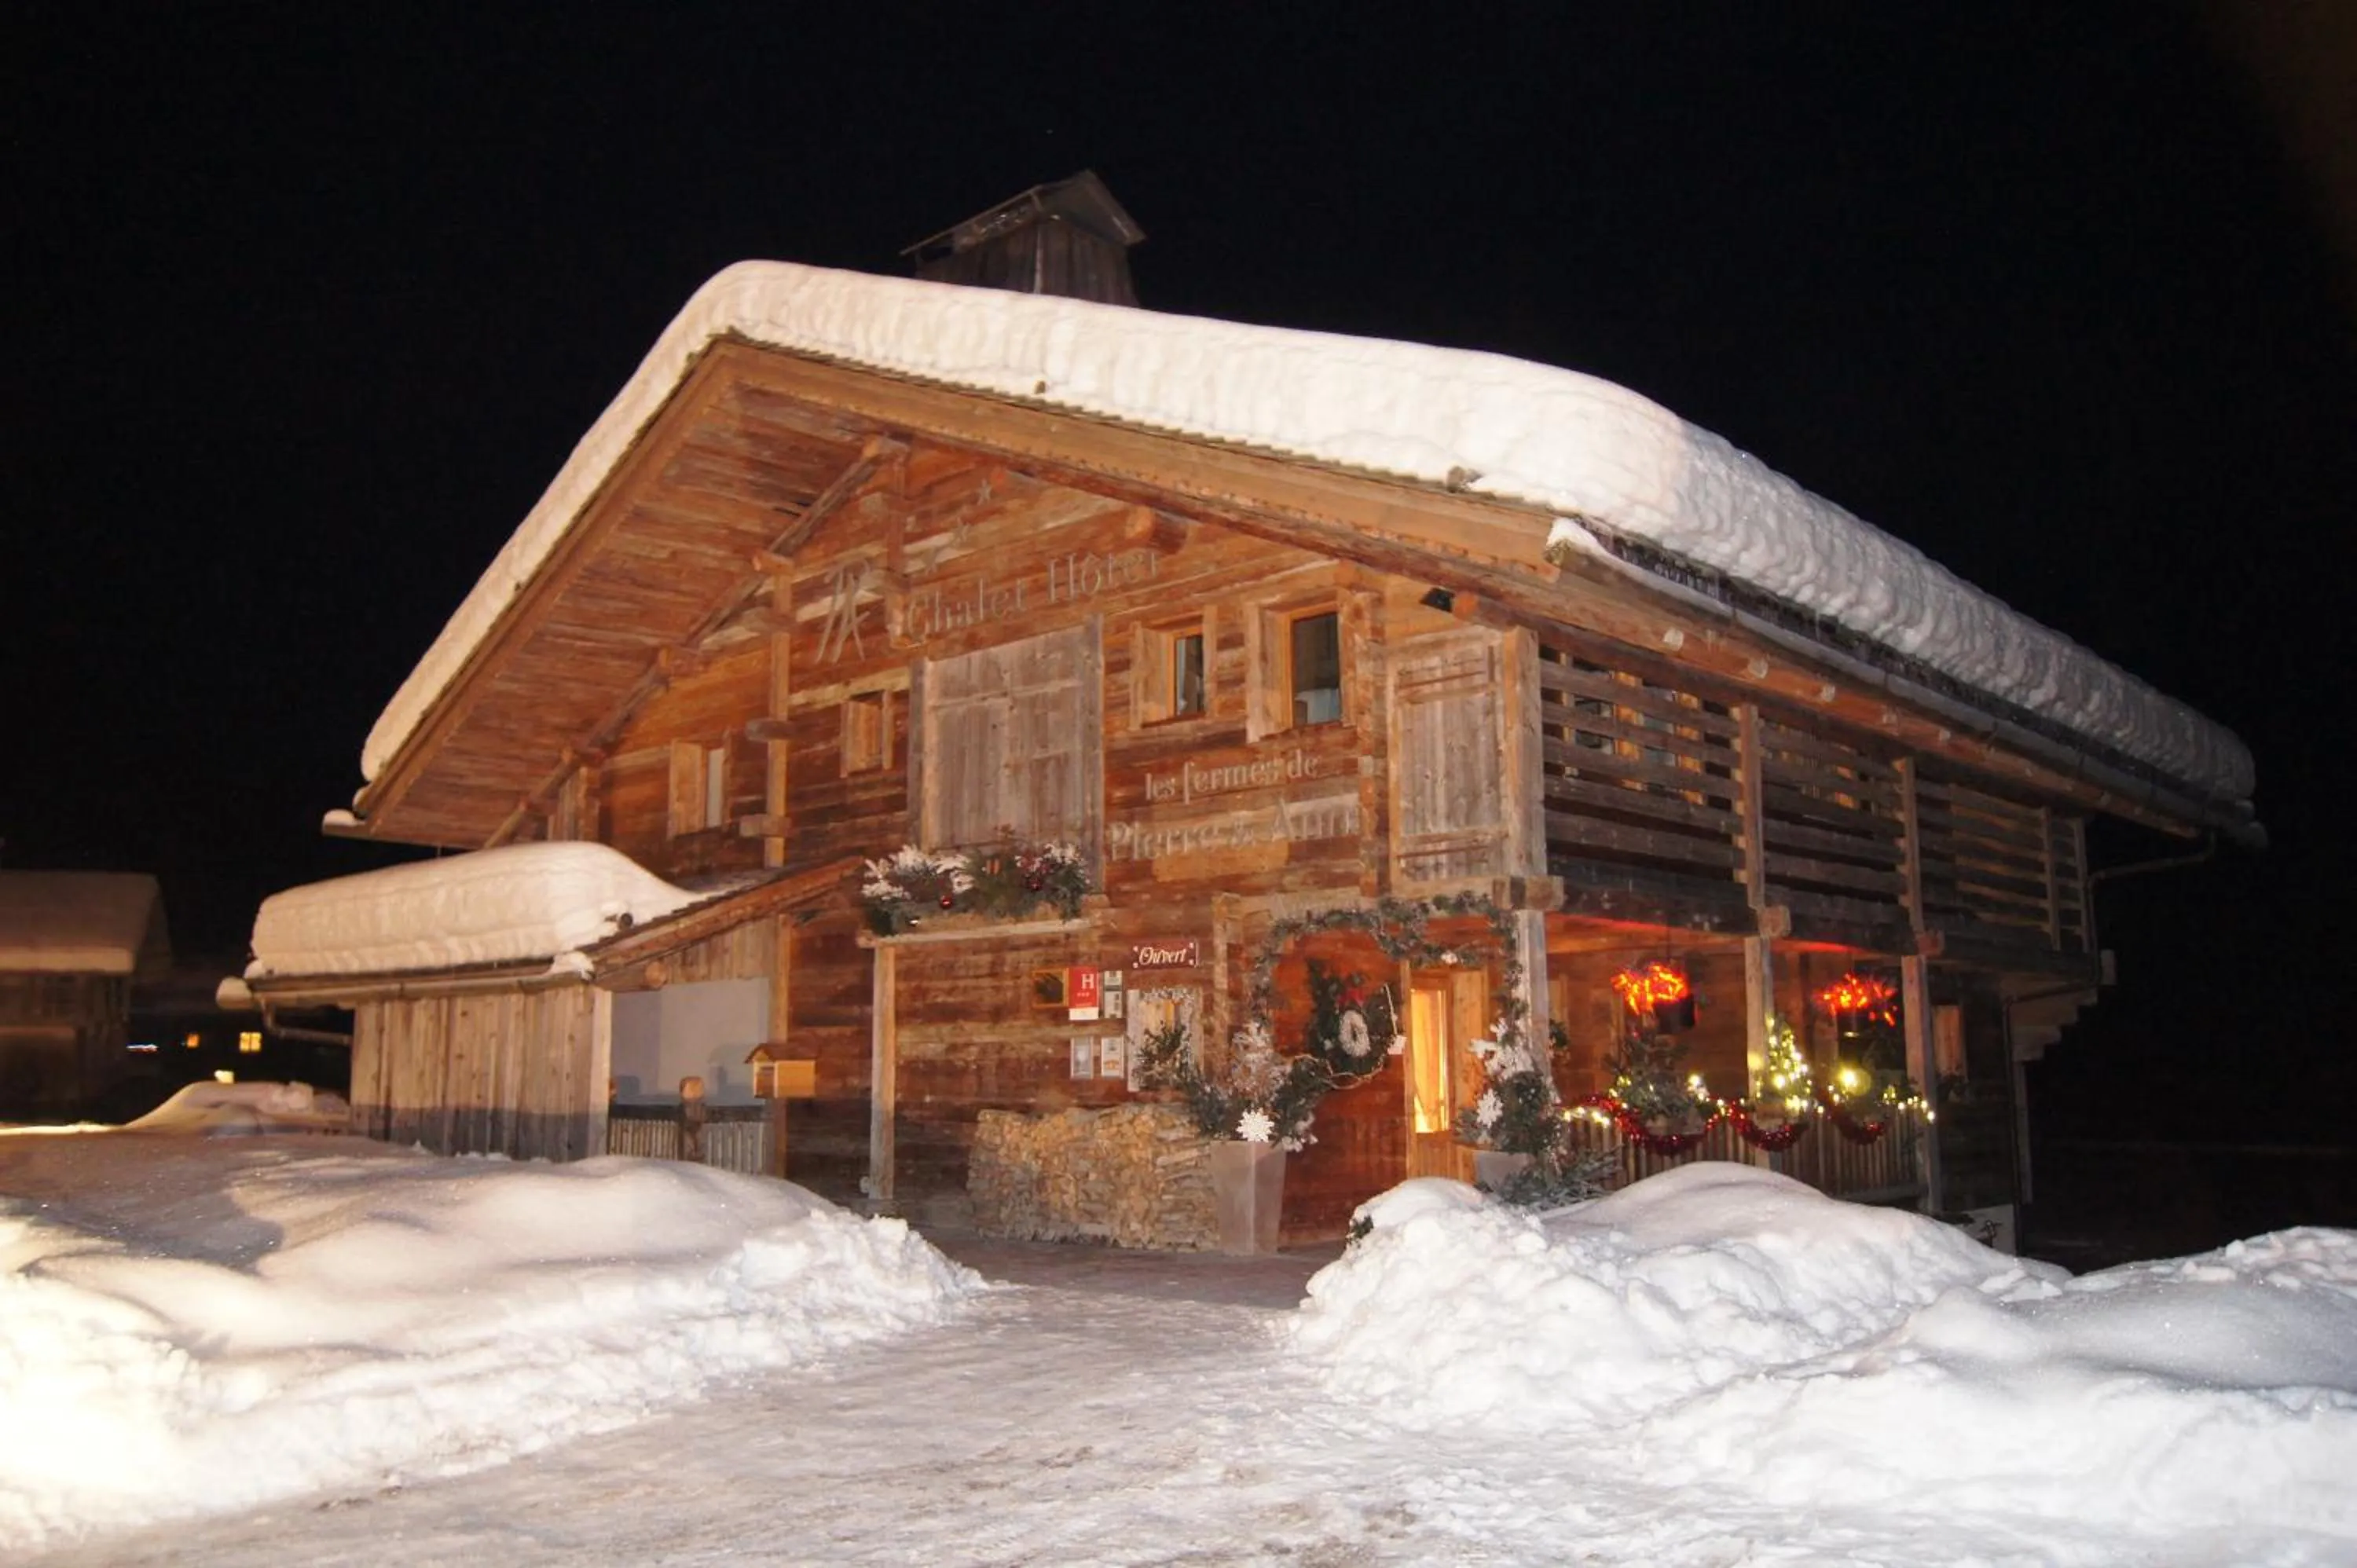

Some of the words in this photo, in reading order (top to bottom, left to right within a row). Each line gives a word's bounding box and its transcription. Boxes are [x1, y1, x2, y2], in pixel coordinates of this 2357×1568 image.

[907, 577, 1028, 639] Chalet
[1145, 772, 1176, 800] les
[1182, 760, 1279, 805] fermes
[1286, 749, 1322, 779] de
[1138, 946, 1187, 966] Ouvert
[1081, 973, 1094, 990] H
